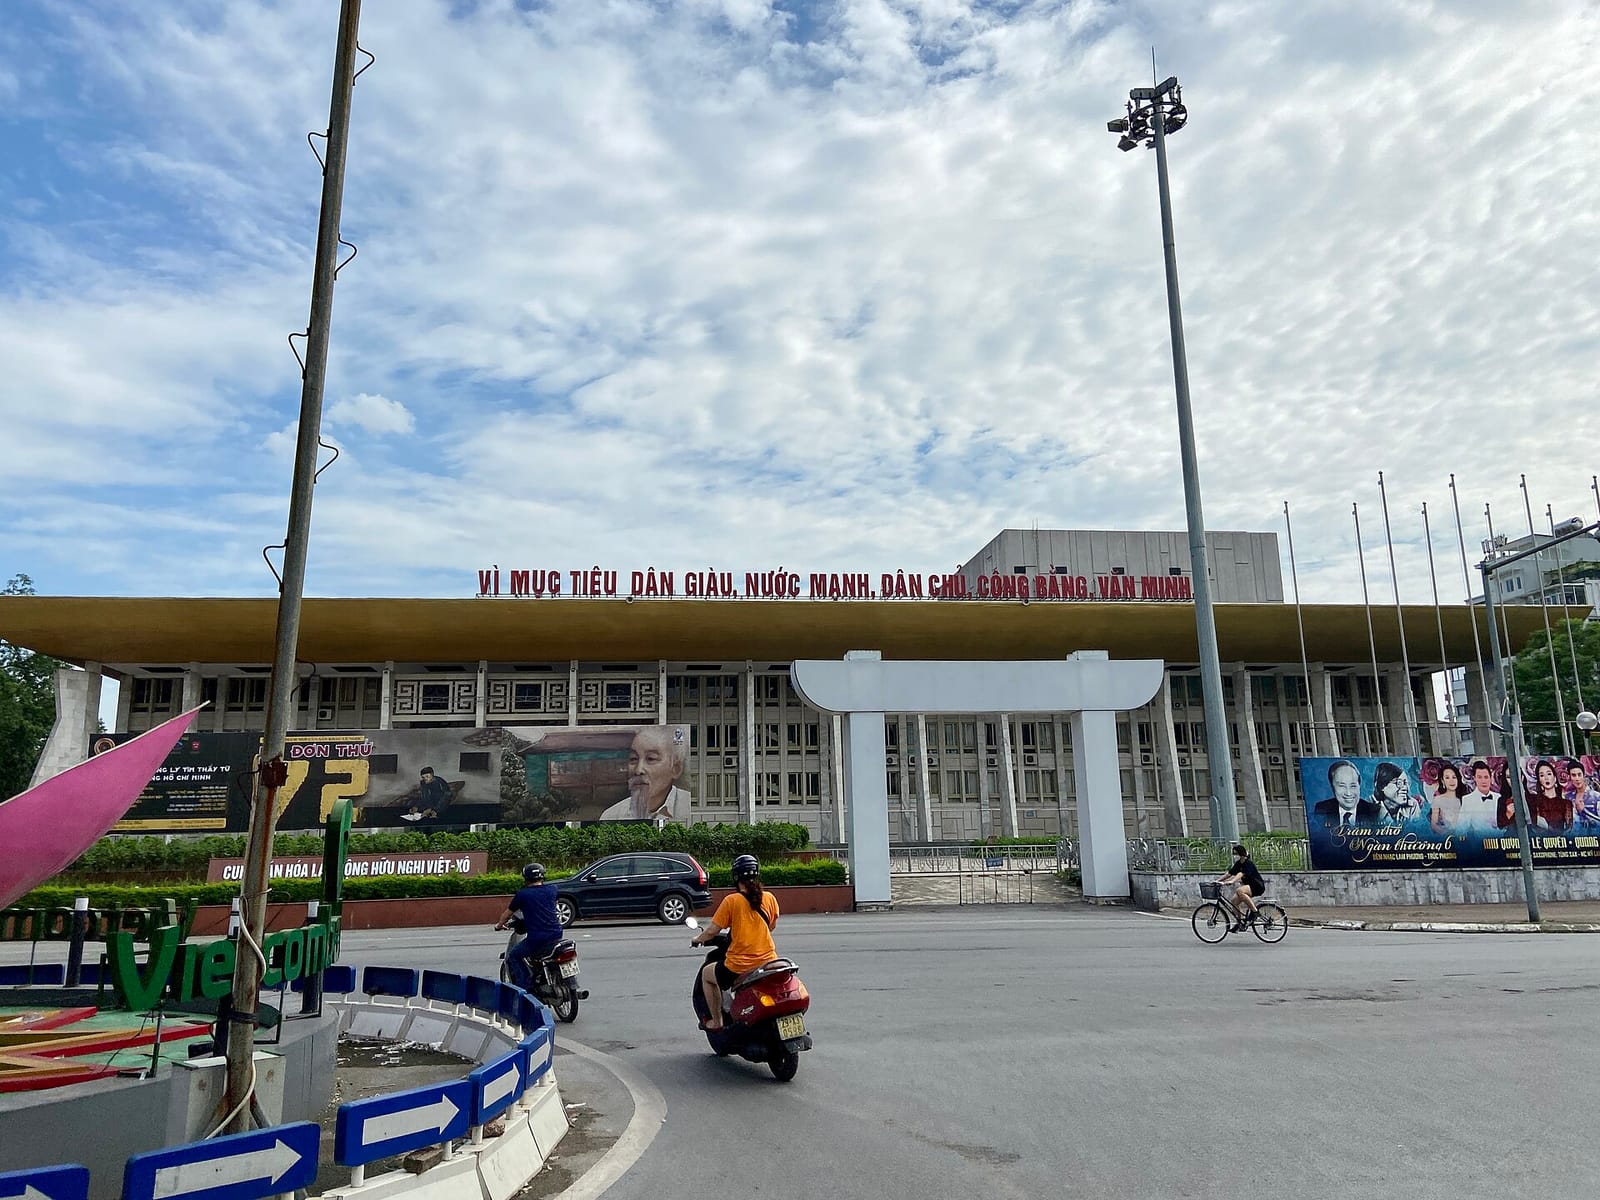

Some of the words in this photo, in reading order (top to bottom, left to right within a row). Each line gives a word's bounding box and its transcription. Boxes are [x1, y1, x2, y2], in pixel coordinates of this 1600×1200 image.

[478, 565, 499, 596] VÌ
[510, 570, 560, 598] MỤC
[570, 566, 617, 596] TIÊU
[631, 566, 674, 596] DÂN
[745, 566, 800, 597] NƯỚC
[881, 569, 922, 597] DÂN
[977, 567, 1029, 598] CÔNG
[1098, 568, 1135, 598] VĂN
[290, 743, 330, 758] ĐƠN
[335, 738, 373, 757] THỨ
[285, 859, 308, 878] HÓA
[344, 858, 368, 879] ỘNG
[370, 856, 395, 876] HỮU
[397, 860, 425, 877] NGHỊ
